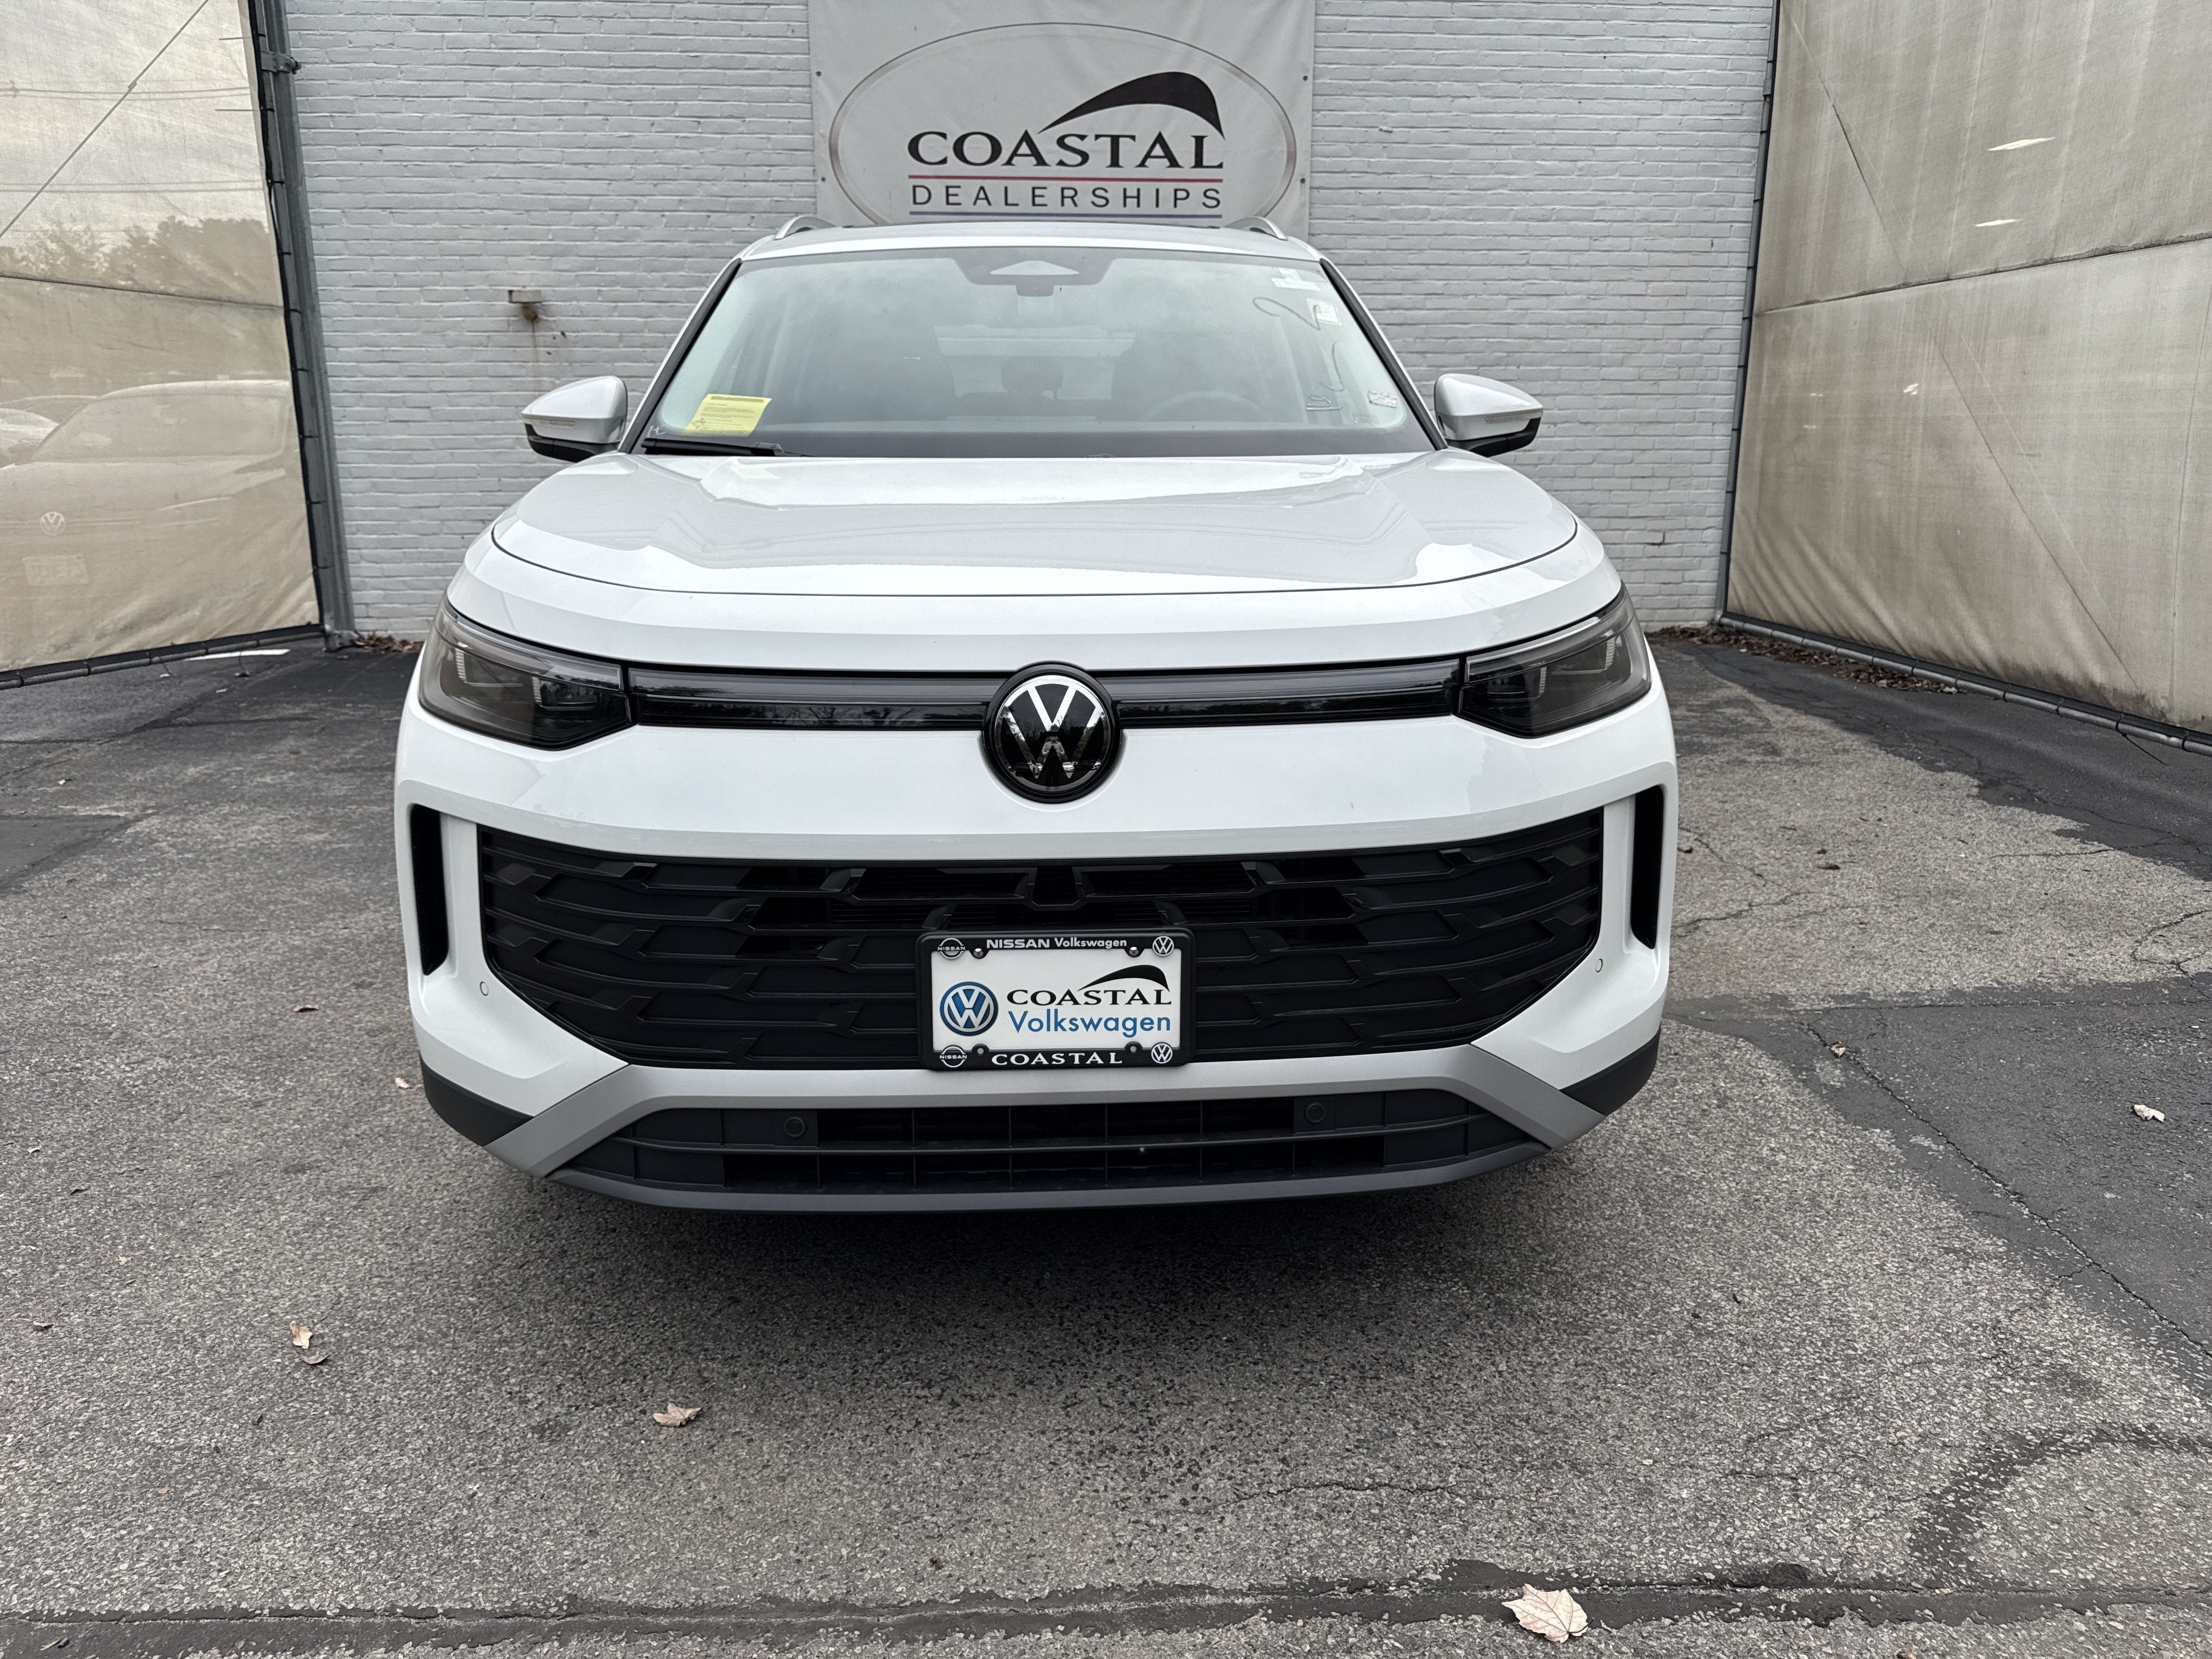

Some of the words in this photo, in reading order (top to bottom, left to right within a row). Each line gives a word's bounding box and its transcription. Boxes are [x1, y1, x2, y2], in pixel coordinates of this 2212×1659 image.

[908, 129, 1223, 169] COASTAL
[912, 185, 1221, 208] DEALERSHIPS
[986, 939, 1050, 949] NISSAN
[1054, 937, 1127, 949] Volkswagen
[1007, 988, 1172, 1006] COASTAL
[1008, 1008, 1170, 1038] Volkswagen
[991, 1052, 1122, 1065] COASTAL
